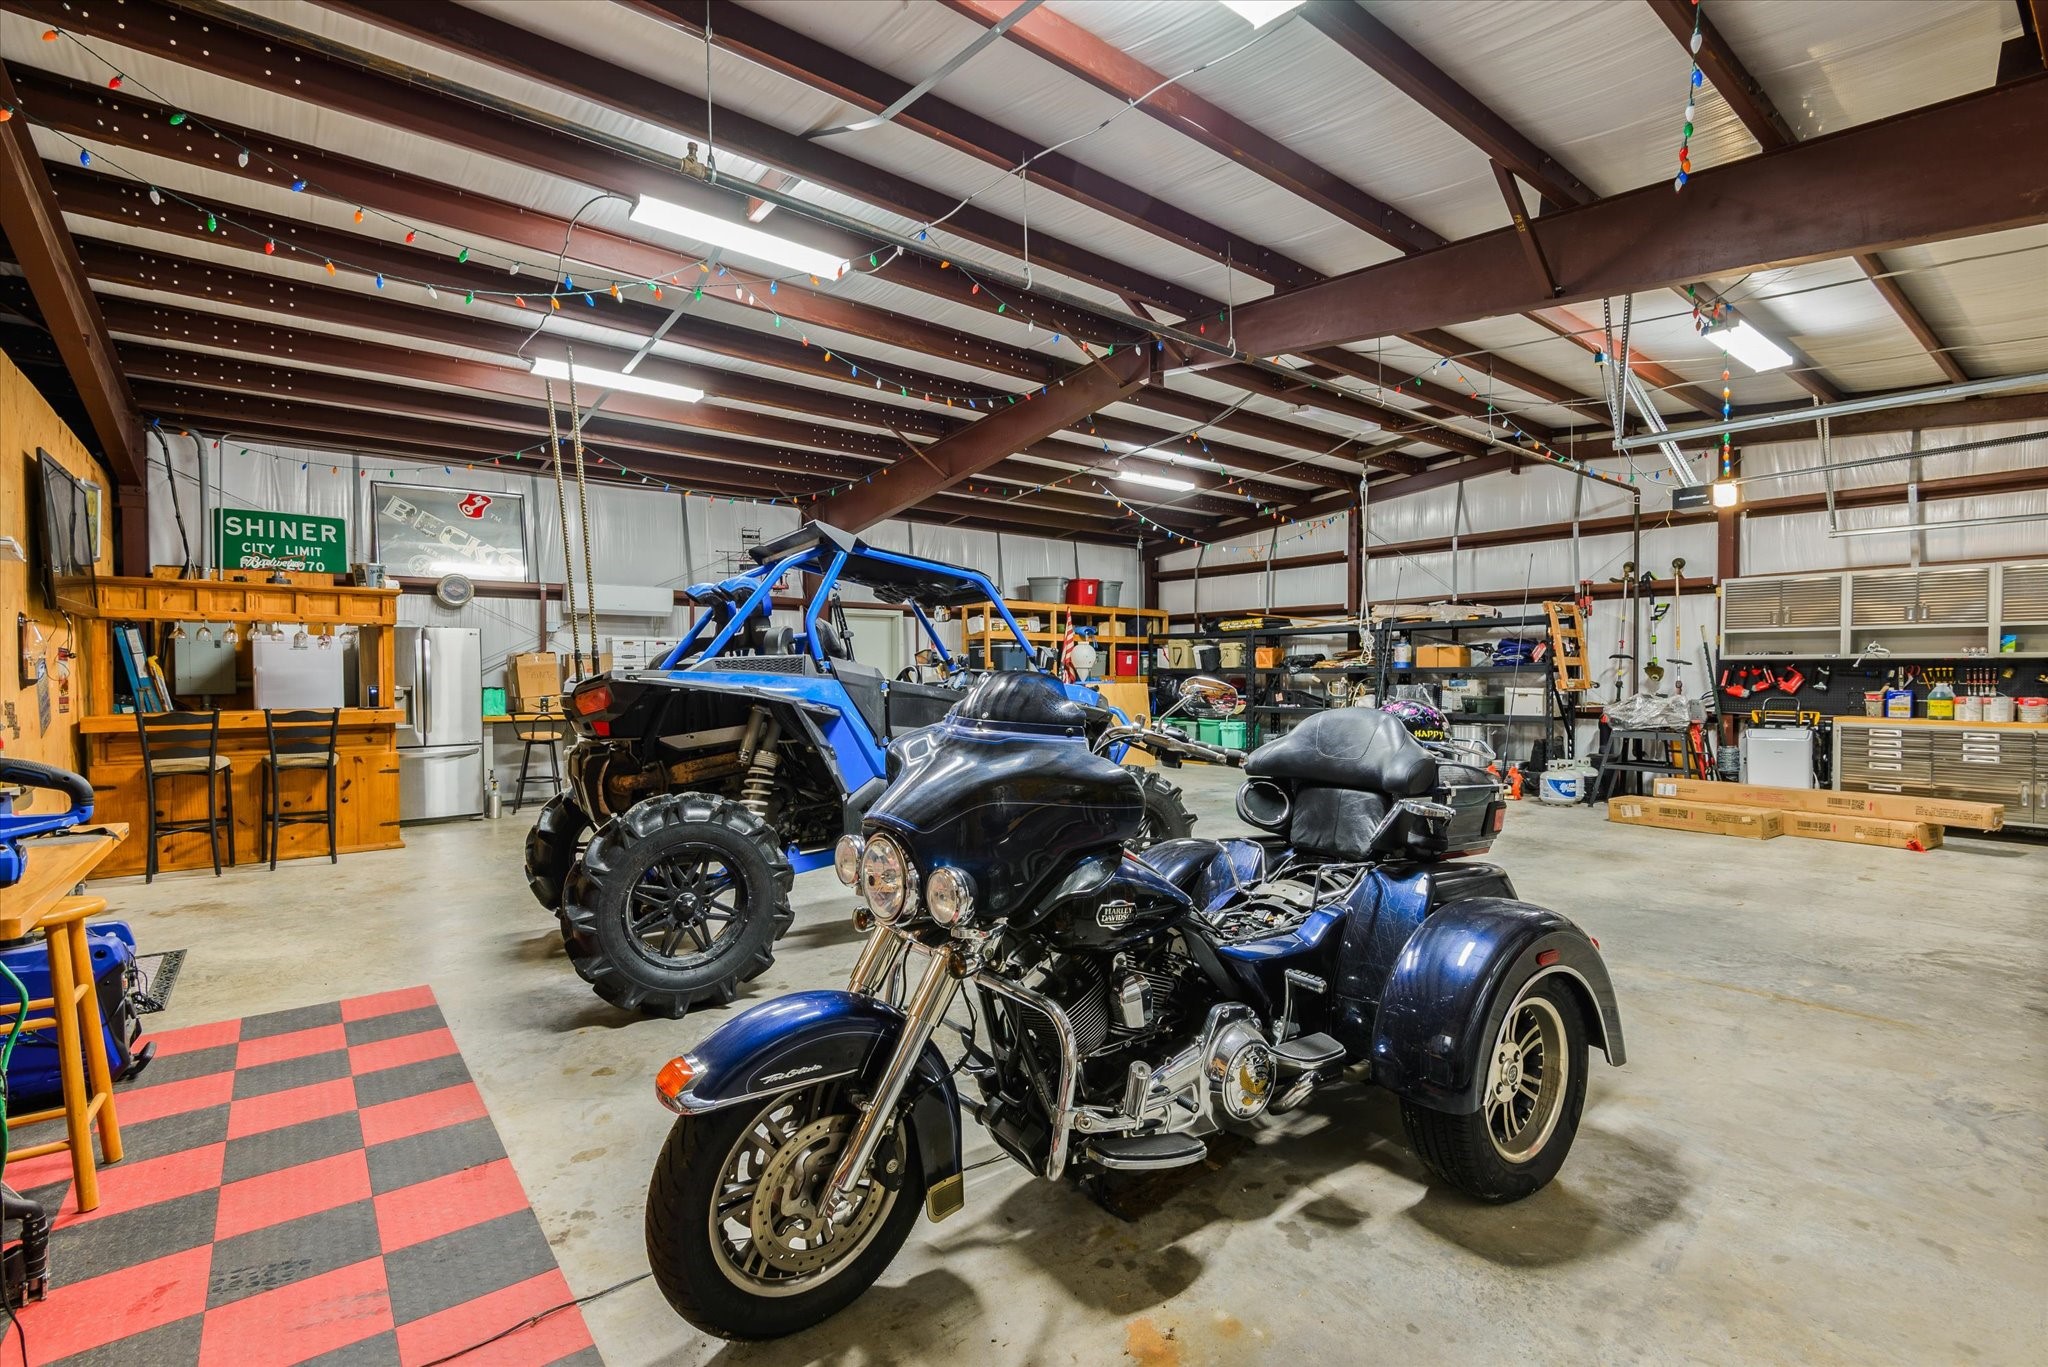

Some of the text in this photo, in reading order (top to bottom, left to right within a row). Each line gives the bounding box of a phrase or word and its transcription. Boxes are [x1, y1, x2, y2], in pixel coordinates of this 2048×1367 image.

[225, 516, 337, 543] SHINER
[241, 542, 323, 557] CITY LIMIT
[1104, 907, 1132, 915] HARLEY
[1101, 914, 1135, 922] DAVIDSO
